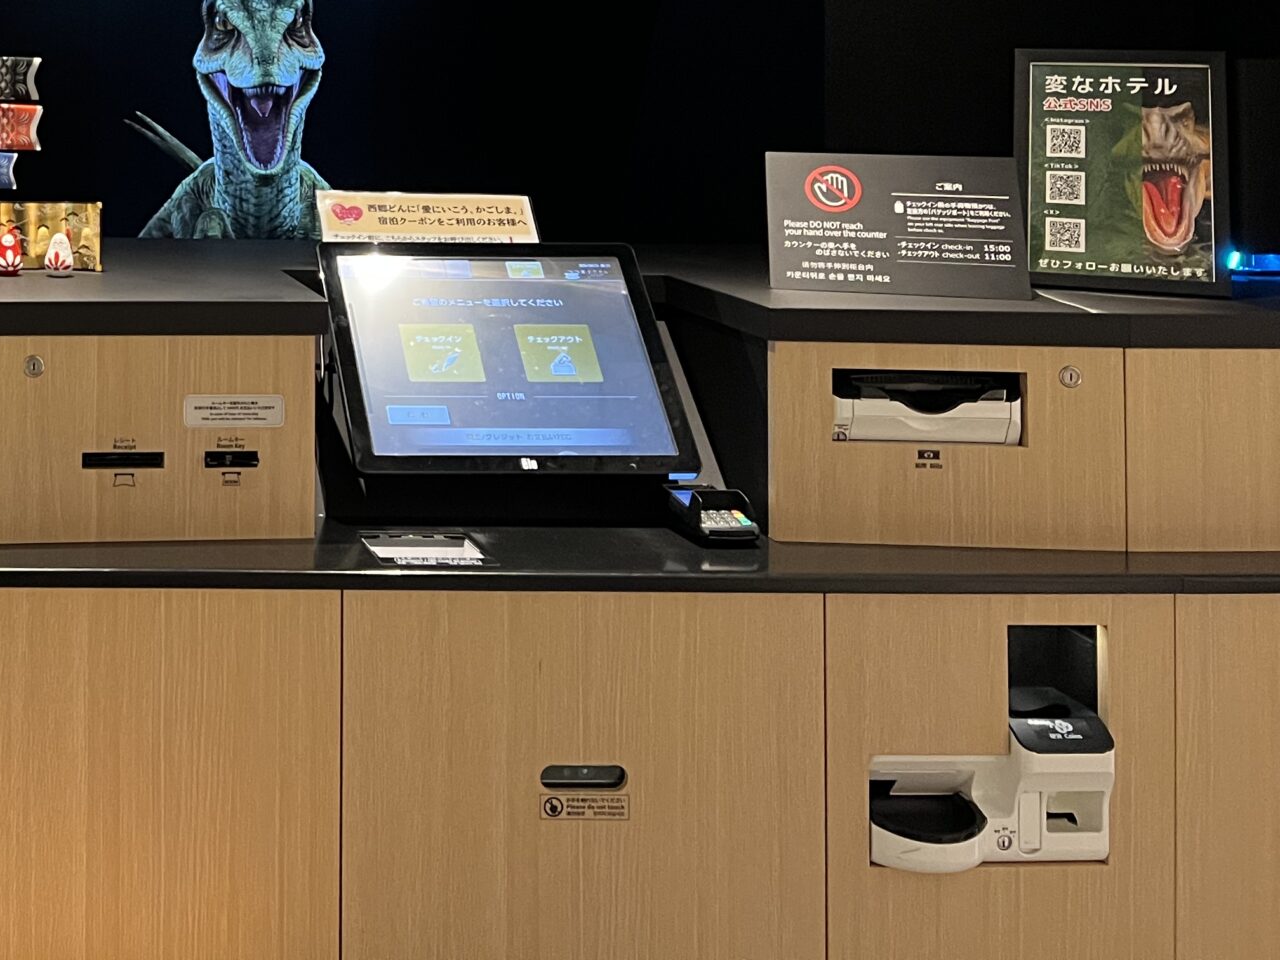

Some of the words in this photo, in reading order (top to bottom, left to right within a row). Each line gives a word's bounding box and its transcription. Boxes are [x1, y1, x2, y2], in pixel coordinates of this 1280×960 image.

[1044, 74, 1178, 96] 変なホテル
[1043, 96, 1112, 112] 公式SNS
[378, 216, 528, 227] 宿泊クーポンをご利用のお客様へ
[783, 219, 808, 228] Please
[809, 220, 822, 229] DO
[823, 221, 841, 229] NOT
[841, 222, 864, 230] reach
[784, 228, 802, 236] your
[803, 228, 823, 236] hand
[824, 229, 842, 237] over
[842, 229, 856, 237] the
[856, 230, 888, 239] counter
[941, 243, 974, 251] check-in
[983, 244, 1011, 253] 15:00
[984, 253, 1012, 261] 11:00
[415, 335, 463, 344] チェックイン
[527, 335, 583, 344] チェックアウト
[496, 392, 526, 401] OPTION
